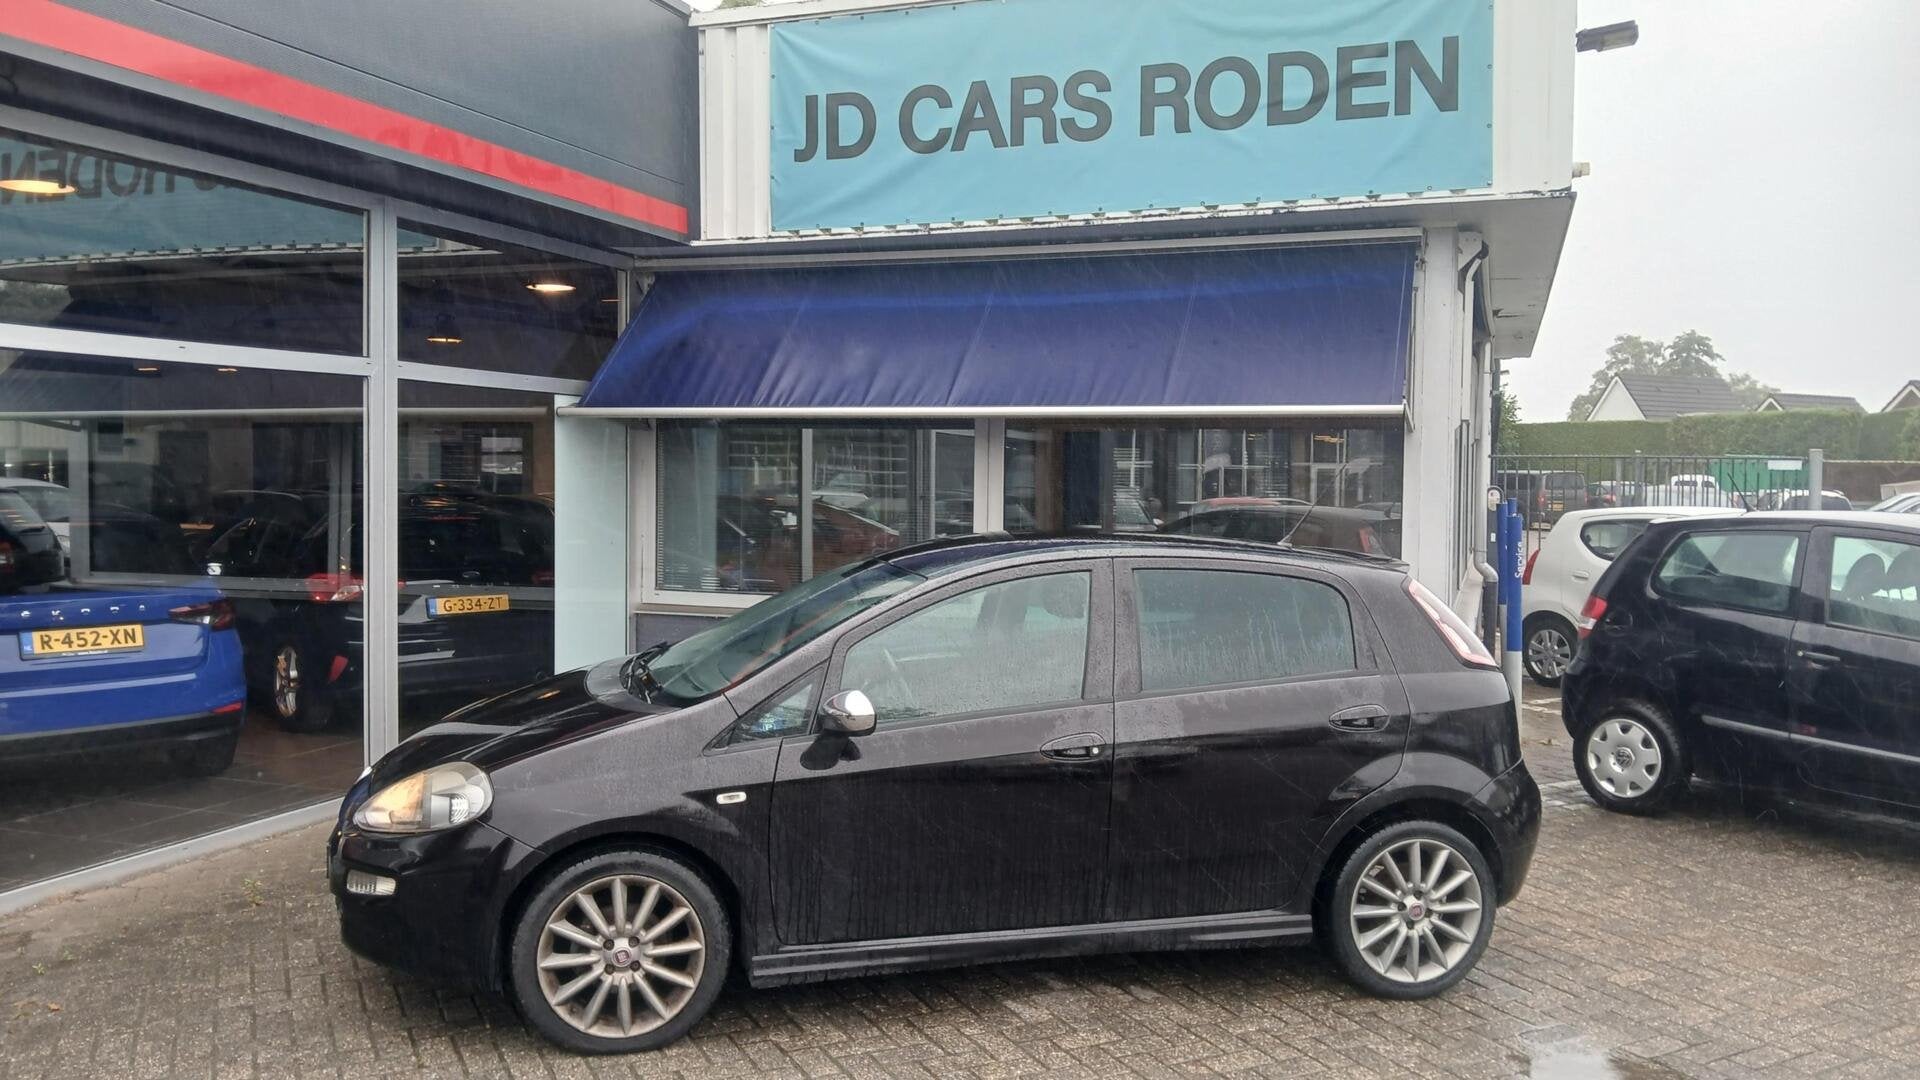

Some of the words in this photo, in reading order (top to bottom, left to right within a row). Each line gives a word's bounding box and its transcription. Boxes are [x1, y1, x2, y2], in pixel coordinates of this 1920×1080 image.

[793, 92, 877, 163] JD
[898, 69, 1113, 155] CARS
[1139, 35, 1460, 137] RODEN
[1514, 541, 1523, 579] Service
[443, 596, 503, 613] G-334-ZT
[40, 628, 137, 650] R-452-XN
